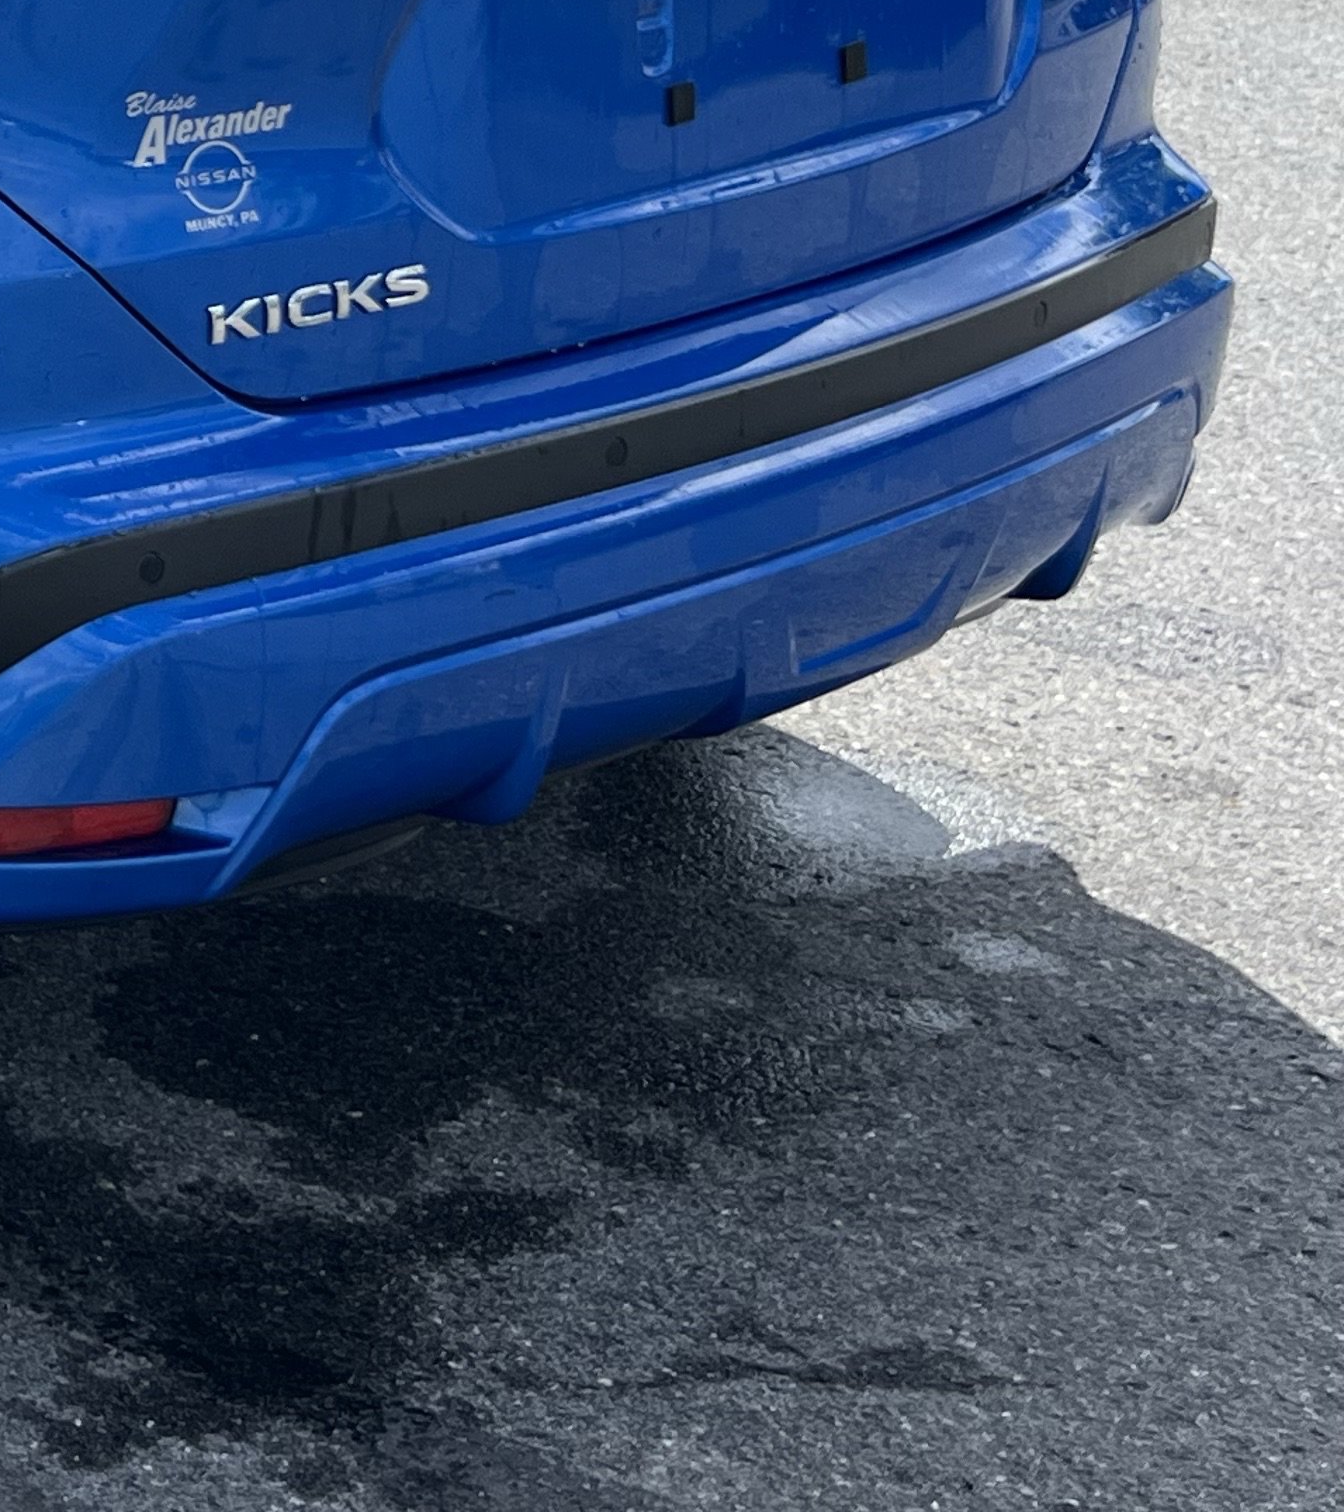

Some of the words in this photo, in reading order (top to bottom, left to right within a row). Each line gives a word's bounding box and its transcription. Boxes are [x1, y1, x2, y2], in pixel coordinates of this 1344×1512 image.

[125, 91, 197, 118] Blaise
[132, 101, 292, 167] Alexander
[175, 165, 257, 189] NISSAN
[240, 210, 259, 225] PA
[207, 264, 430, 345] KICKS
